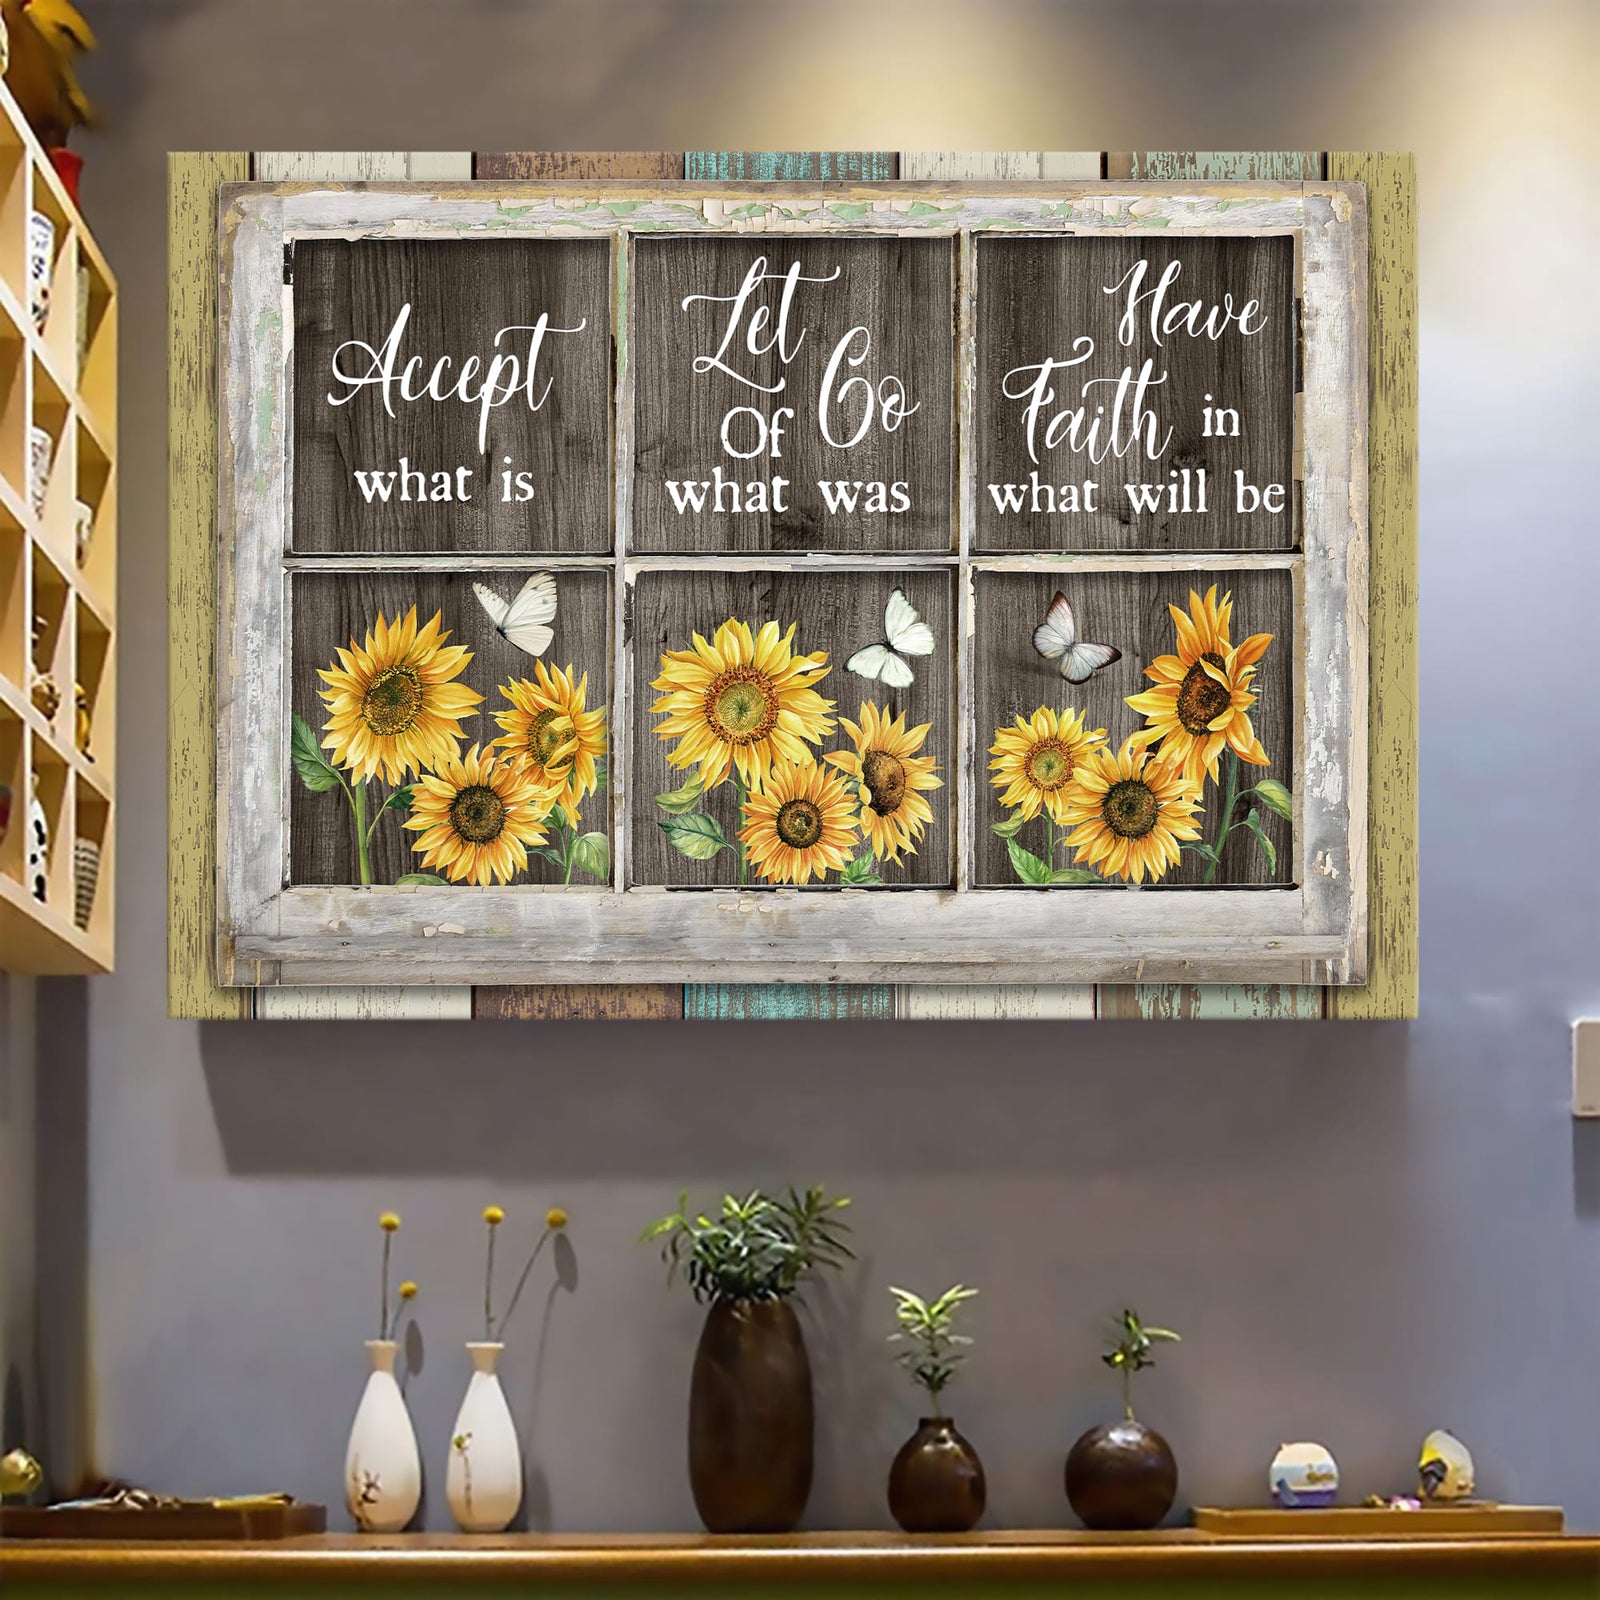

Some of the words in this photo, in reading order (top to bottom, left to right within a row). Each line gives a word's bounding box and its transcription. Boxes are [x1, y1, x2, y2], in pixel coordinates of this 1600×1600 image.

[682, 256, 841, 393] Let
[1103, 259, 1268, 348] Have
[327, 303, 587, 455] Accept
[1002, 336, 1174, 465] Faith
[1201, 394, 1241, 438] in
[353, 457, 474, 504] what
[501, 456, 535, 503] is
[665, 467, 790, 515] what
[818, 480, 911, 515] was
[987, 469, 1099, 515] what
[1123, 468, 1208, 515] will
[1234, 468, 1285, 515] be
